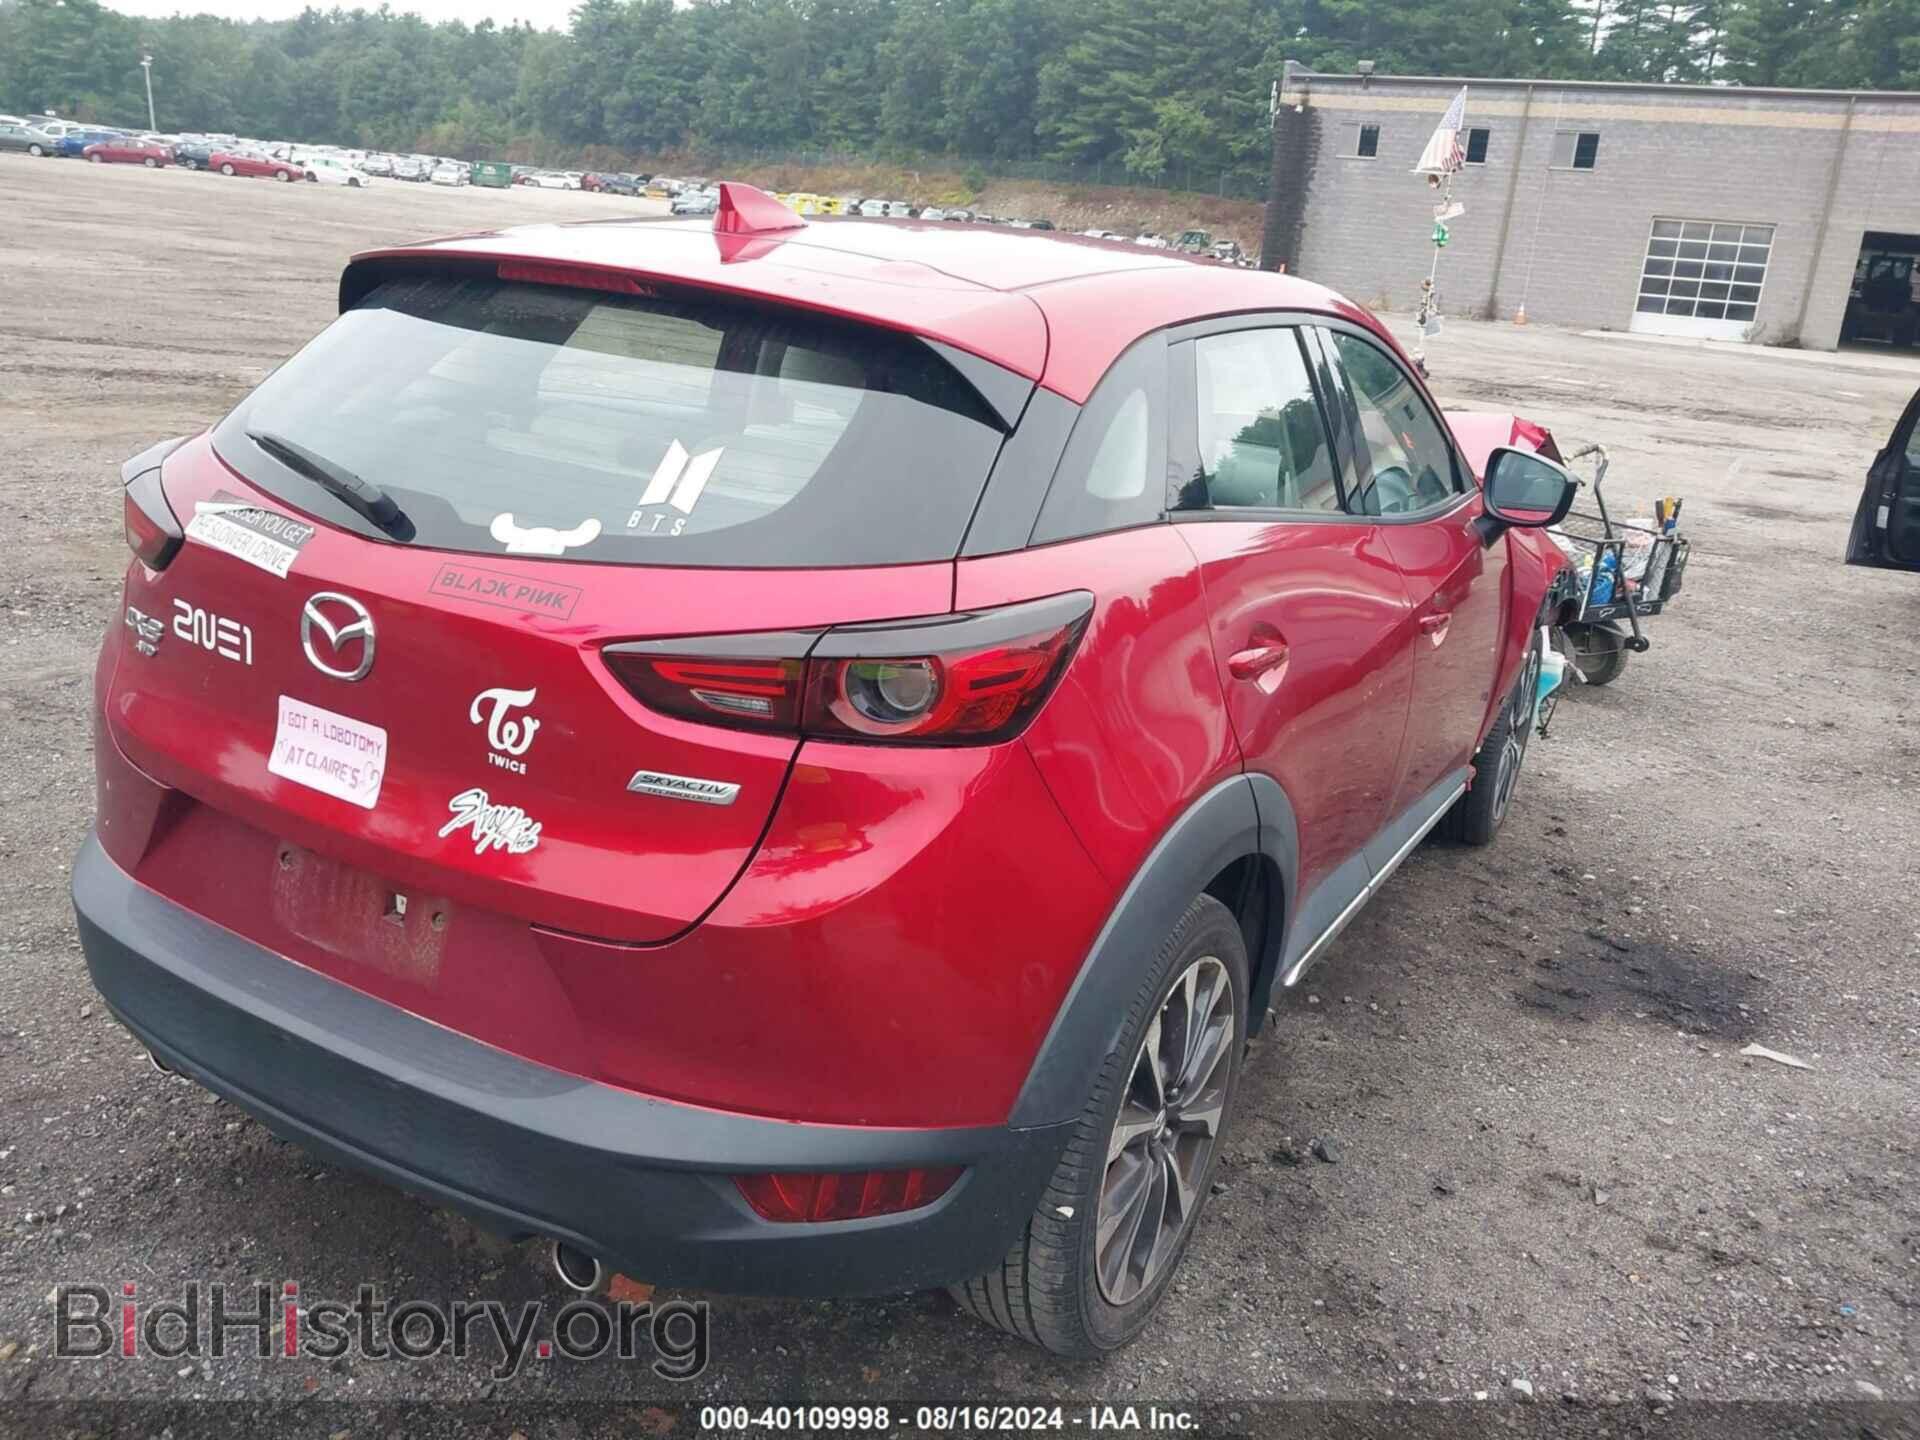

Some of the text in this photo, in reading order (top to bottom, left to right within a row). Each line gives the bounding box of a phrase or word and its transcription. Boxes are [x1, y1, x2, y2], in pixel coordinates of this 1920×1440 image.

[261, 513, 289, 535] YOU
[284, 524, 312, 545] GET
[627, 510, 687, 536] BTS
[252, 540, 292, 571] DRIVE
[173, 598, 253, 666] 2NE1
[288, 711, 307, 730] GOT
[312, 718, 319, 734] A
[323, 722, 382, 758] LOBOTOMY
[284, 745, 360, 789] AT CLAIRE'S
[488, 752, 527, 775] TWICE
[640, 774, 729, 794] SKYACTIV
